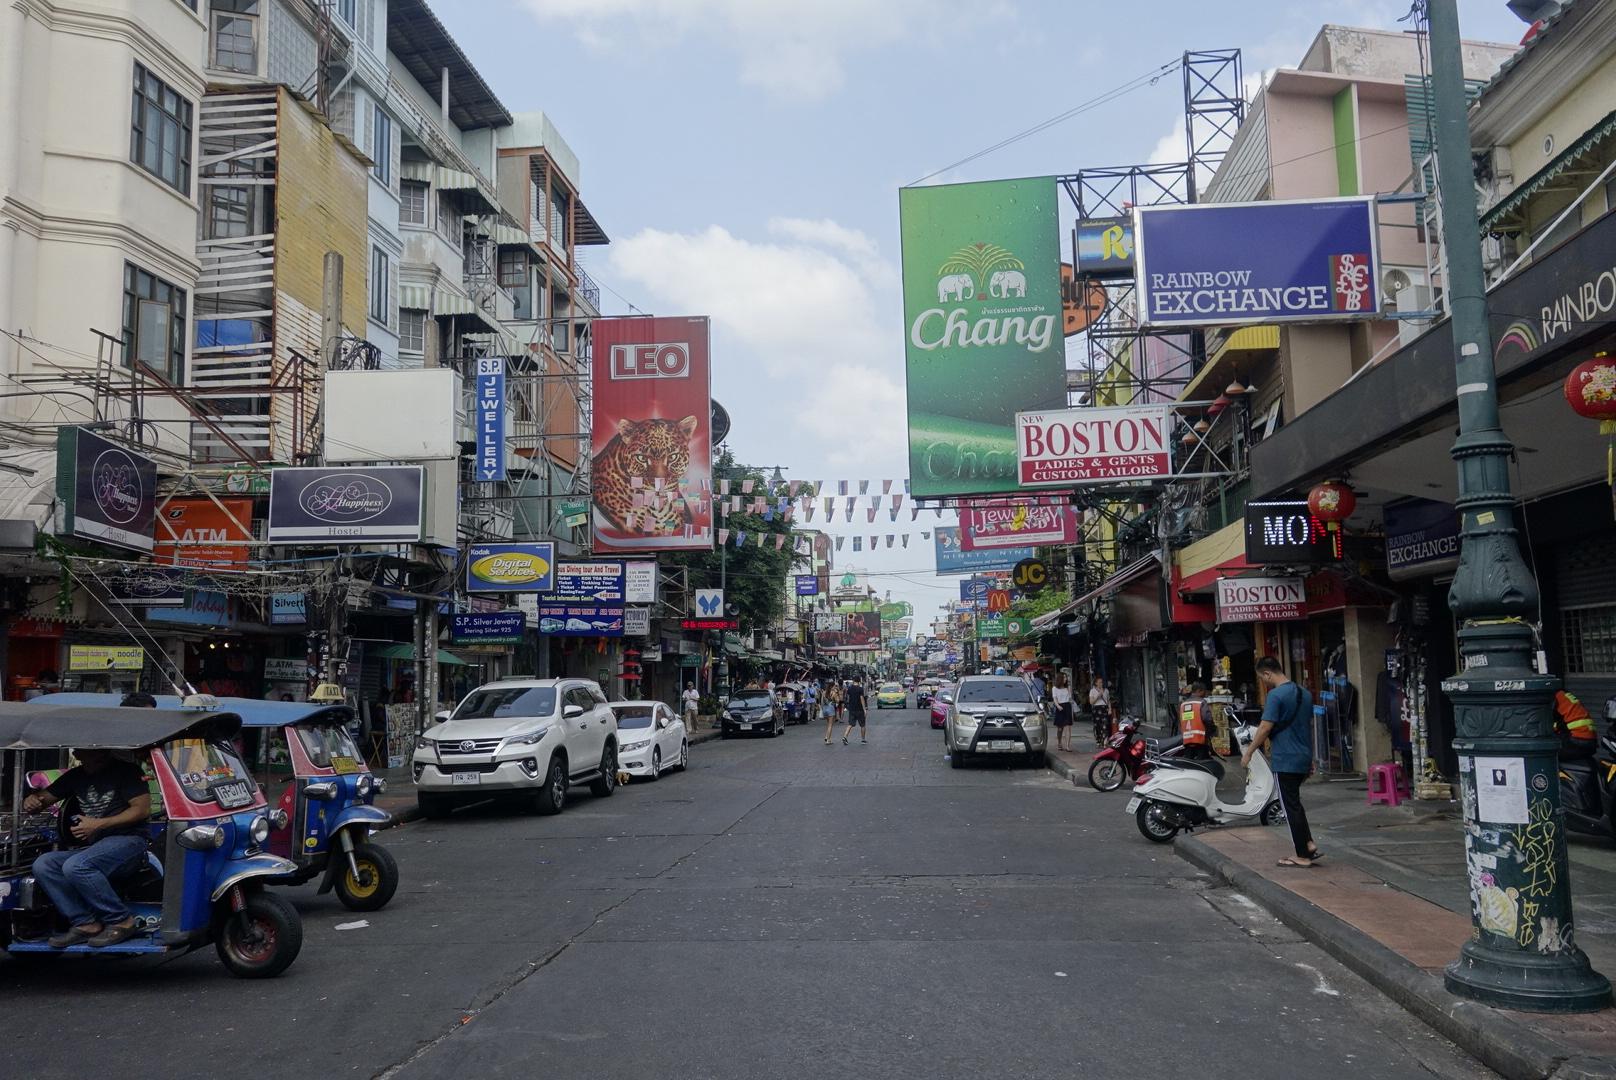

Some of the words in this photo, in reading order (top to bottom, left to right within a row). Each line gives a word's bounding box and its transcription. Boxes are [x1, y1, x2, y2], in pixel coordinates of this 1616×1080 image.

[1151, 270, 1252, 289] RAINBOW
[1152, 286, 1328, 315] EXCHANGE
[1541, 266, 1616, 344] RAINBO
[911, 308, 1056, 353] Chang
[481, 360, 500, 373] S.P.
[613, 344, 688, 378] LEO
[1021, 415, 1045, 424] NEW
[481, 377, 499, 479] JEWELLERY
[1023, 416, 1163, 458] BOSTON
[1035, 458, 1085, 470] LADIES
[1091, 458, 1102, 467] &
[1109, 455, 1155, 466] GENTS
[1032, 469, 1091, 481] CUSTOM
[1097, 465, 1158, 477] TAILORS
[338, 499, 383, 509] Happiness
[181, 528, 228, 547] ATM
[328, 527, 363, 535] Hostel
[1388, 530, 1425, 548] RAINBOW
[1389, 536, 1457, 564] EXCHANGE
[489, 567, 536, 576] Services
[493, 558, 533, 569] Digital
[566, 565, 582, 574] Diving
[1016, 565, 1046, 585] JC
[1224, 584, 1300, 604] BOSTON
[1228, 605, 1259, 613] LADIES
[455, 617, 472, 626] S.P.
[473, 618, 493, 626] Silver
[493, 618, 521, 626] Jewelry
[117, 650, 142, 658] noodle
[325, 687, 339, 696] TAXI
